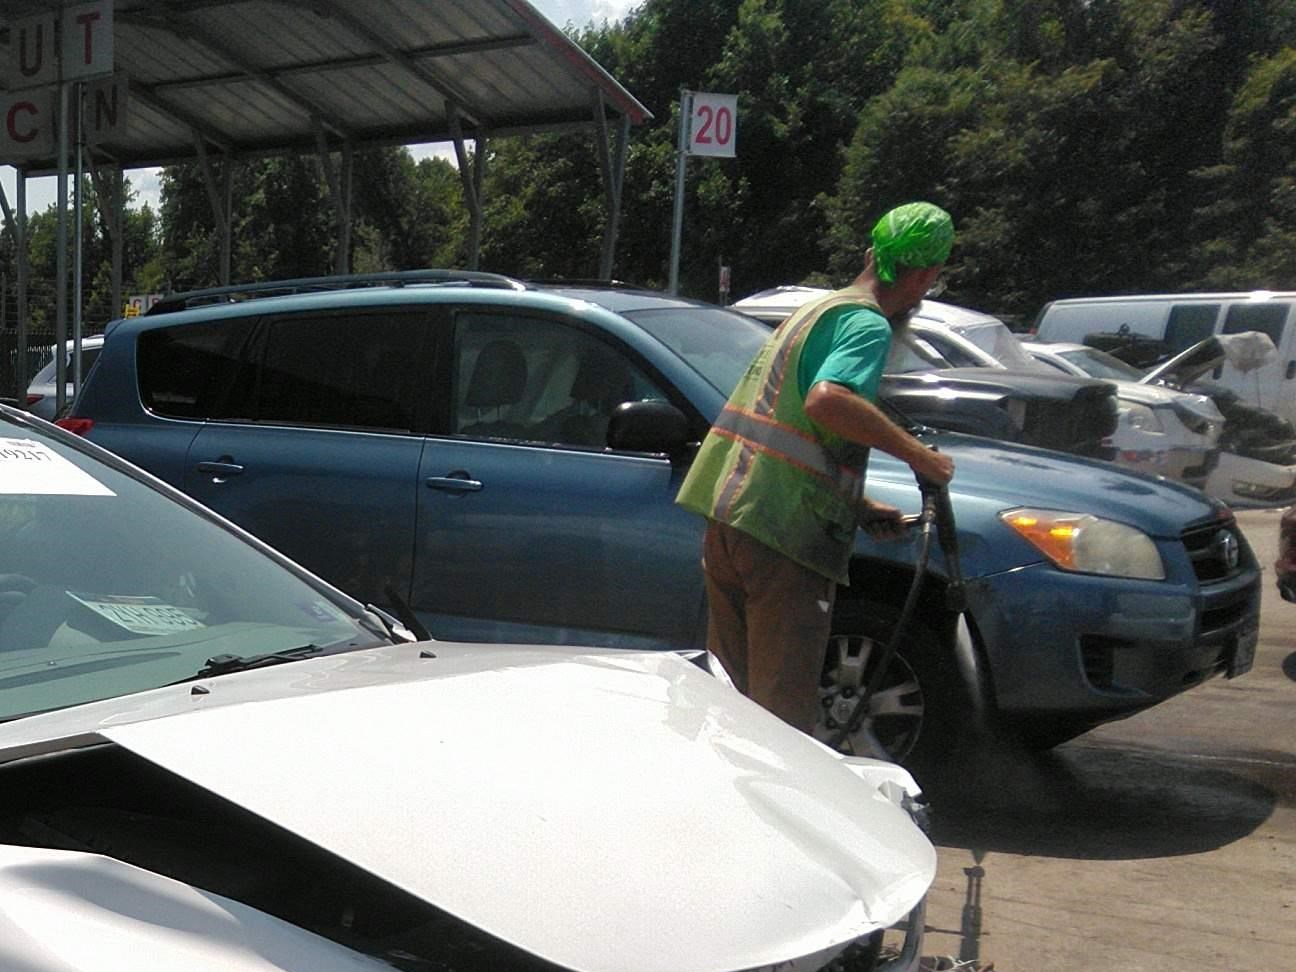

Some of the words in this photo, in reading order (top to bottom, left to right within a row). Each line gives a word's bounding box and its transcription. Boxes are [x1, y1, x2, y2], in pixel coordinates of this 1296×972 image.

[19, 23, 43, 77] U
[76, 11, 101, 65] T
[7, 101, 38, 143] C
[95, 83, 118, 131] N
[695, 105, 732, 145] 20
